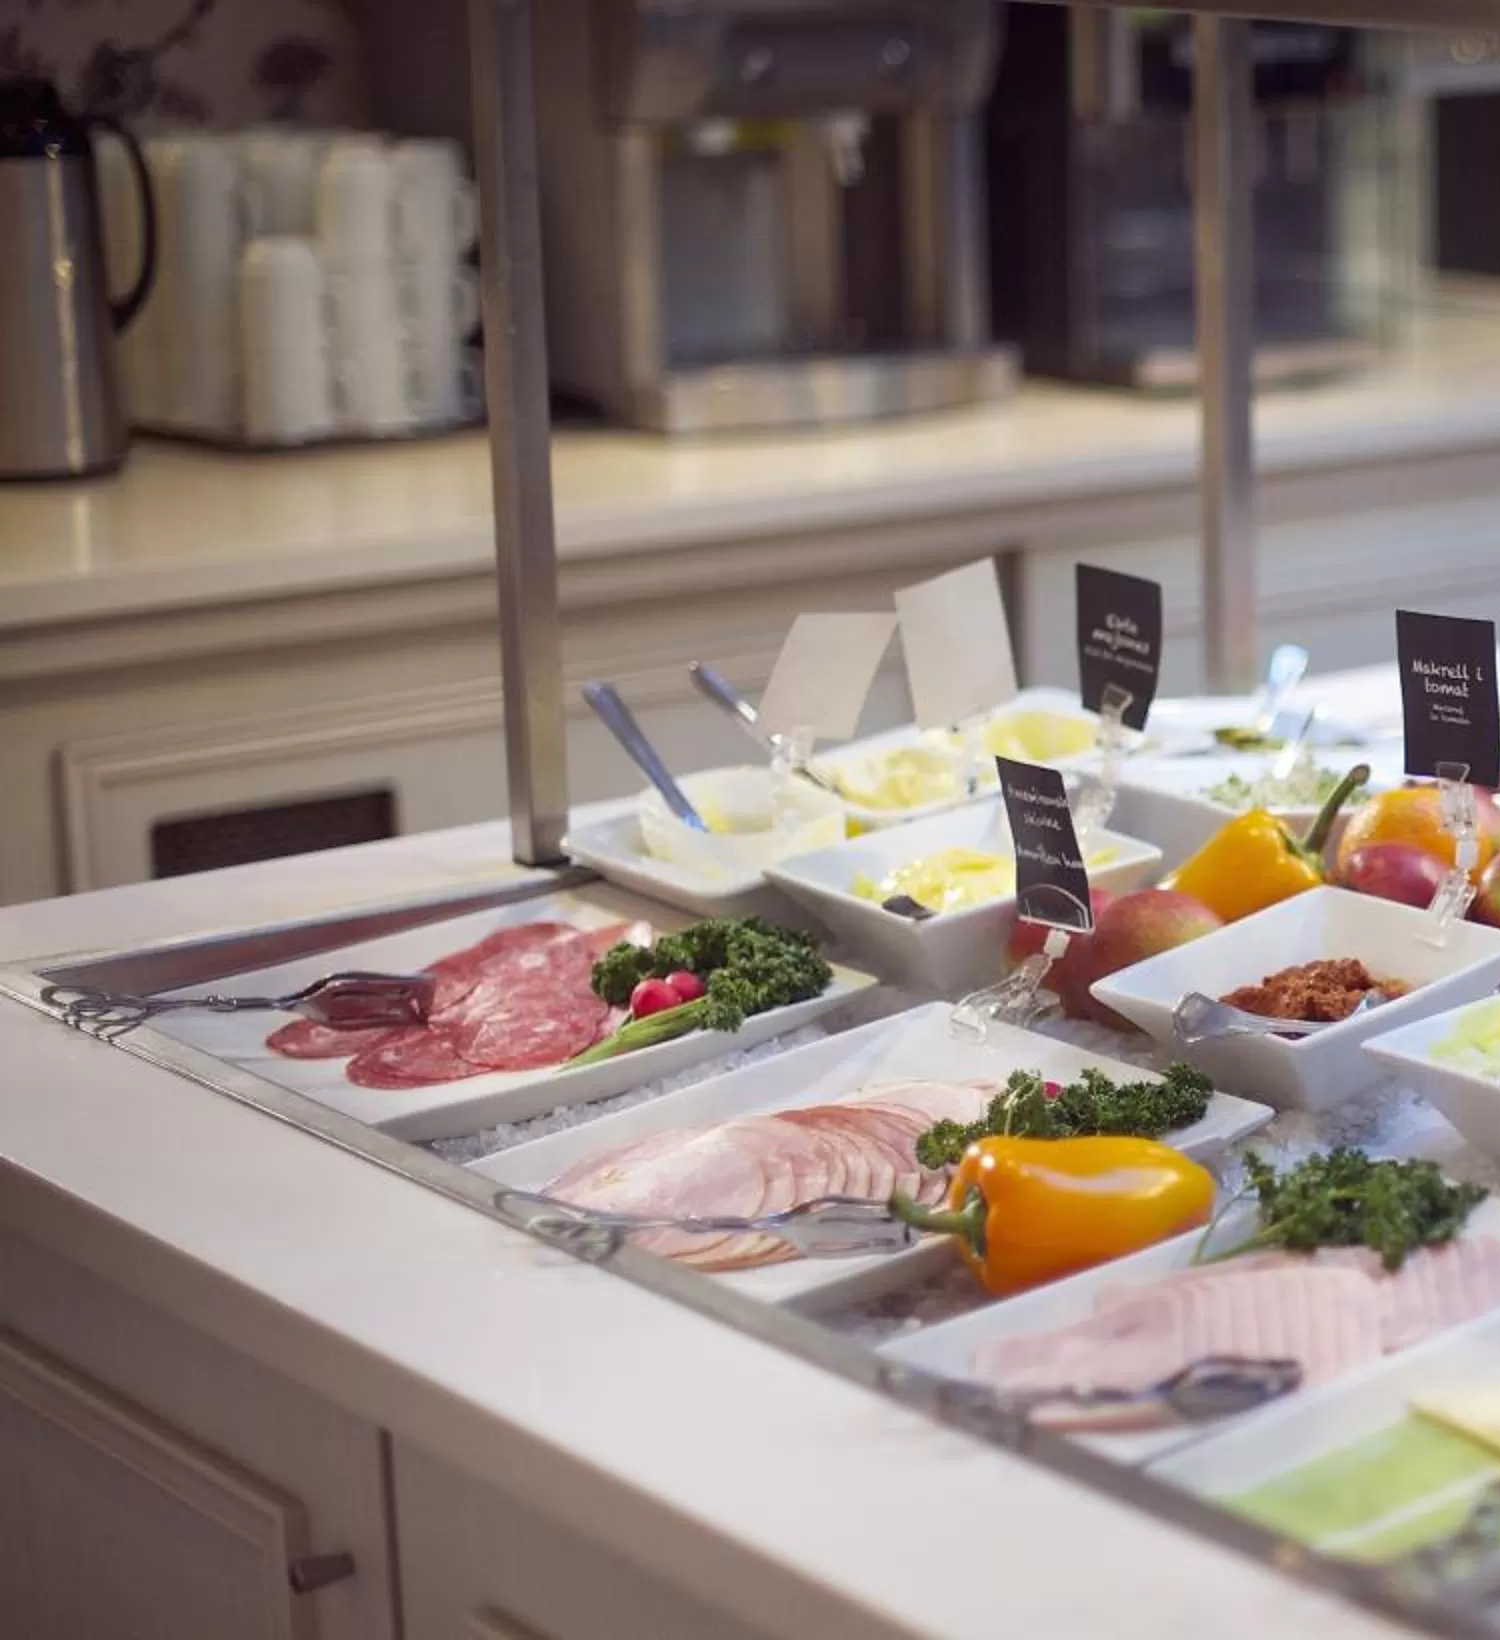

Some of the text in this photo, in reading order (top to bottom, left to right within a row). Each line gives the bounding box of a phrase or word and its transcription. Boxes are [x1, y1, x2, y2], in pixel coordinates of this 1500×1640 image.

[1412, 658, 1483, 681] Makrell i
[1425, 677, 1469, 698] tomat
